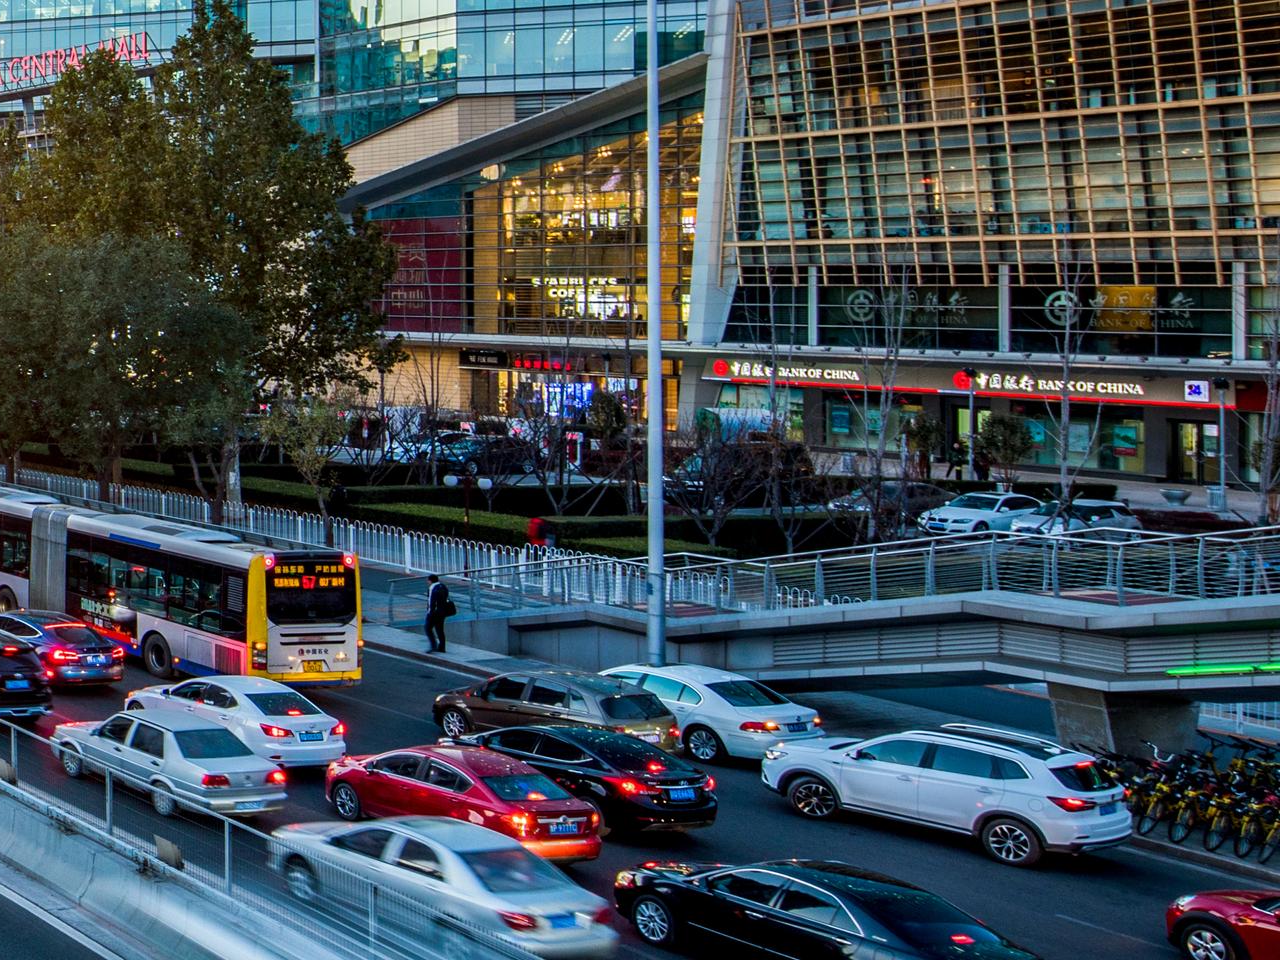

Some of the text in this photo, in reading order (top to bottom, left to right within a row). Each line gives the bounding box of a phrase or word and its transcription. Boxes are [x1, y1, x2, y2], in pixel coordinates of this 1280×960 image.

[392, 289, 424, 309] 中心
[1089, 291, 1196, 319] 中国银行
[1090, 318, 1122, 329] BANK
[1130, 319, 1146, 329] OF
[807, 368, 822, 379] OF
[823, 369, 860, 381] CHINA
[976, 372, 1035, 391] 中国银行
[1037, 379, 1144, 395] BANK OF CHINA
